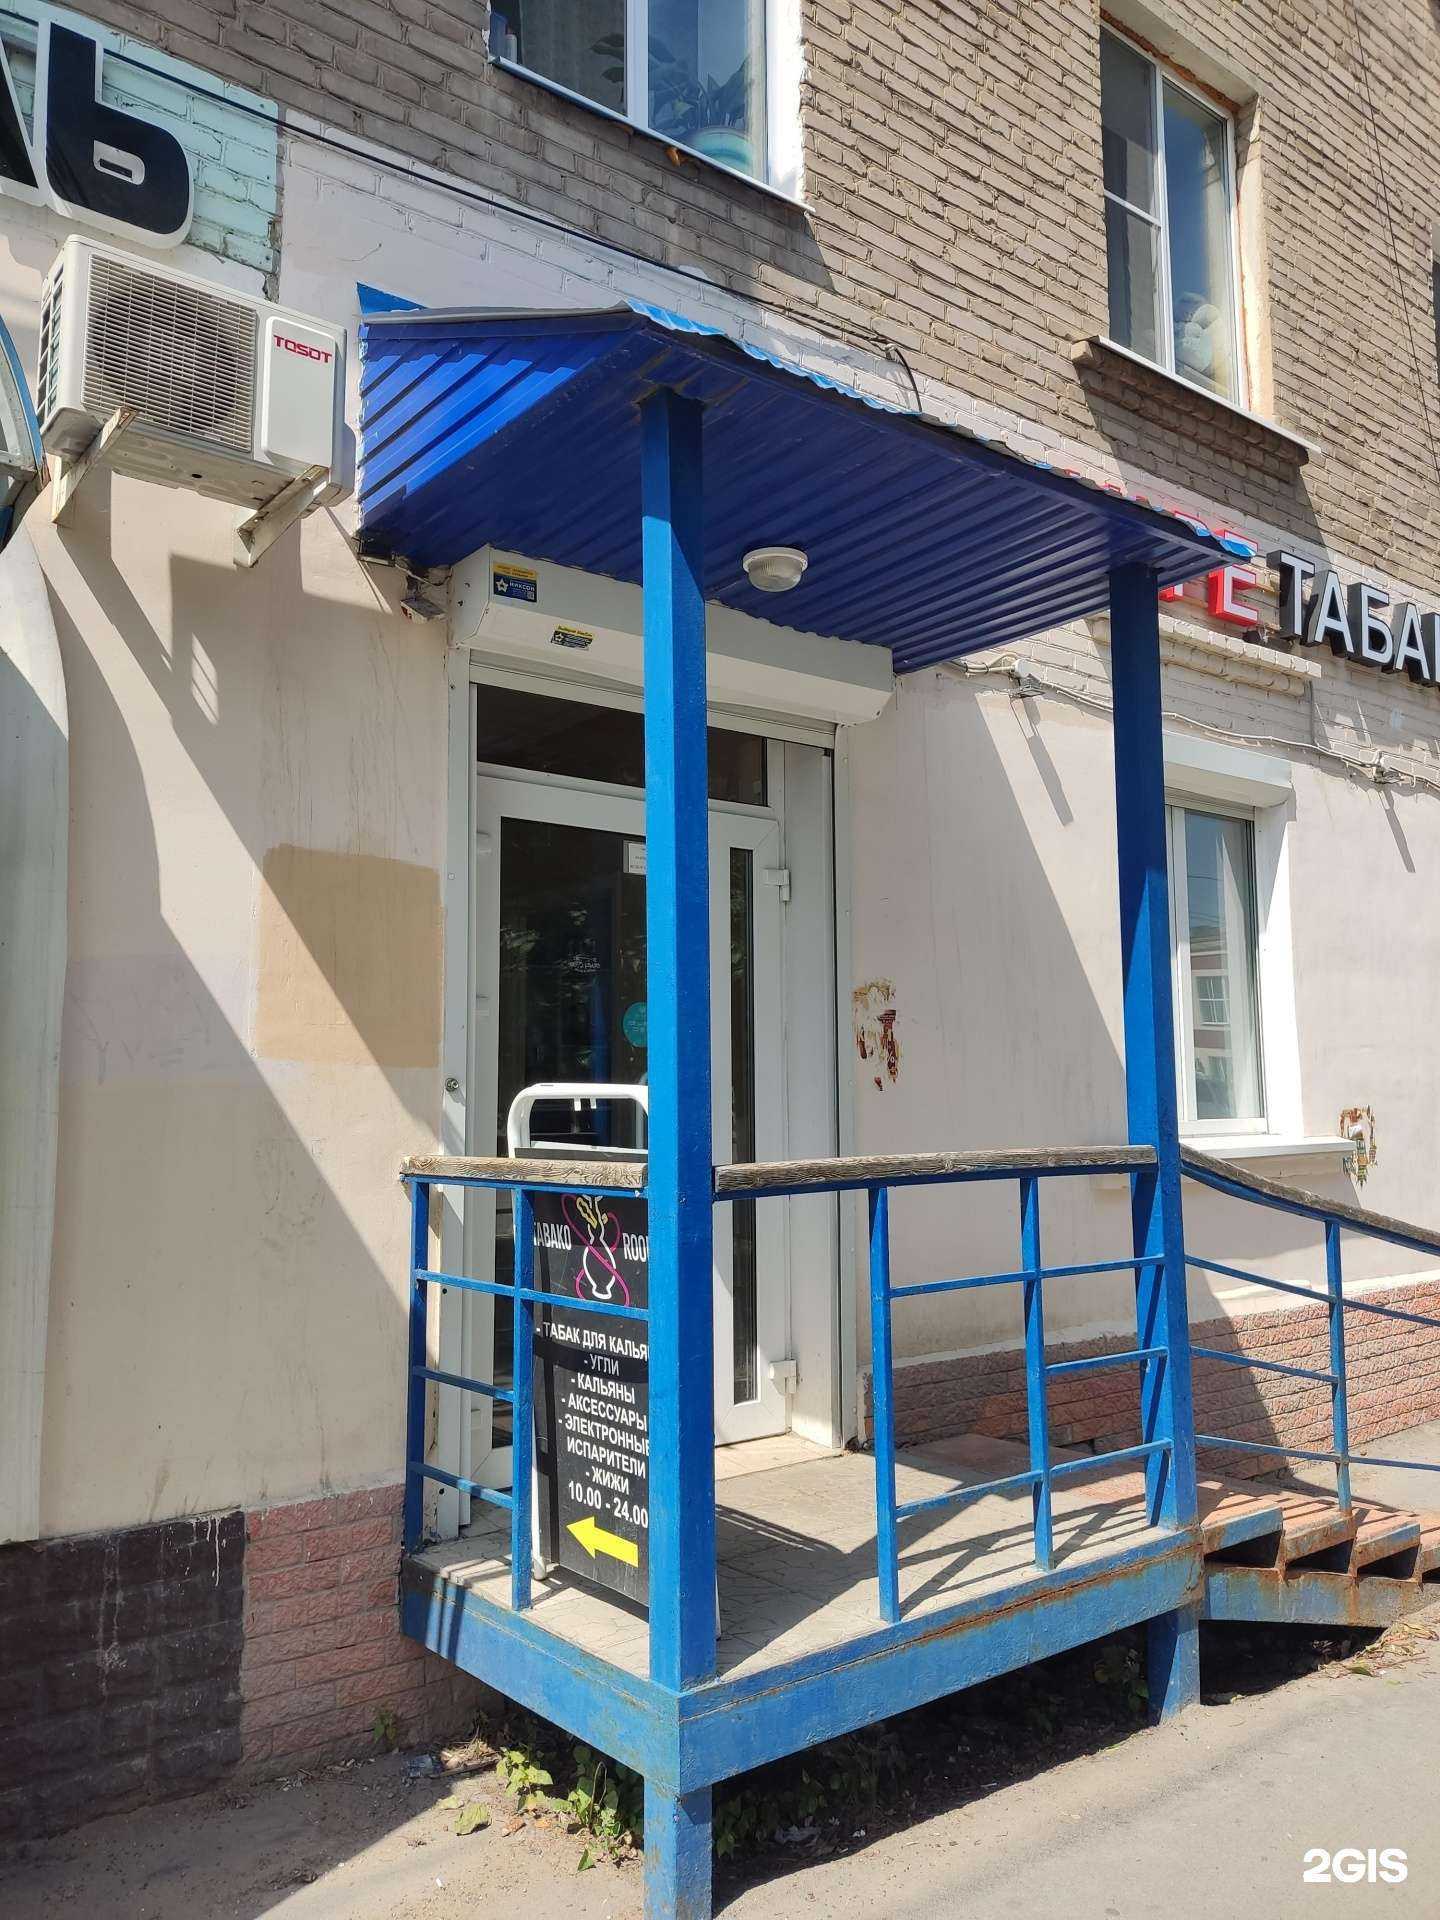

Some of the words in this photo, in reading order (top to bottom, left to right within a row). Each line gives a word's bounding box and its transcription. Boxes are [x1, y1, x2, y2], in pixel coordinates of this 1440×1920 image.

[273, 335, 332, 363] TOSOT
[1267, 550, 1440, 687] ТАБА
[622, 1233, 649, 1263] ROO
[543, 1322, 580, 1344] ТАБАК
[582, 1329, 606, 1350] ДЛЯ
[609, 1335, 649, 1361] КАЛЬЯ
[590, 1353, 620, 1376] УГЛИ
[577, 1372, 635, 1404] КАЛЬЯНЫ
[568, 1392, 648, 1432] АКСЕССУАРЫ
[567, 1436, 646, 1479] ИСПАРИТЕЛИ
[591, 1465, 629, 1495] ЖИЖИ
[568, 1480, 602, 1509] 10.00
[613, 1497, 648, 1529] 24.00
